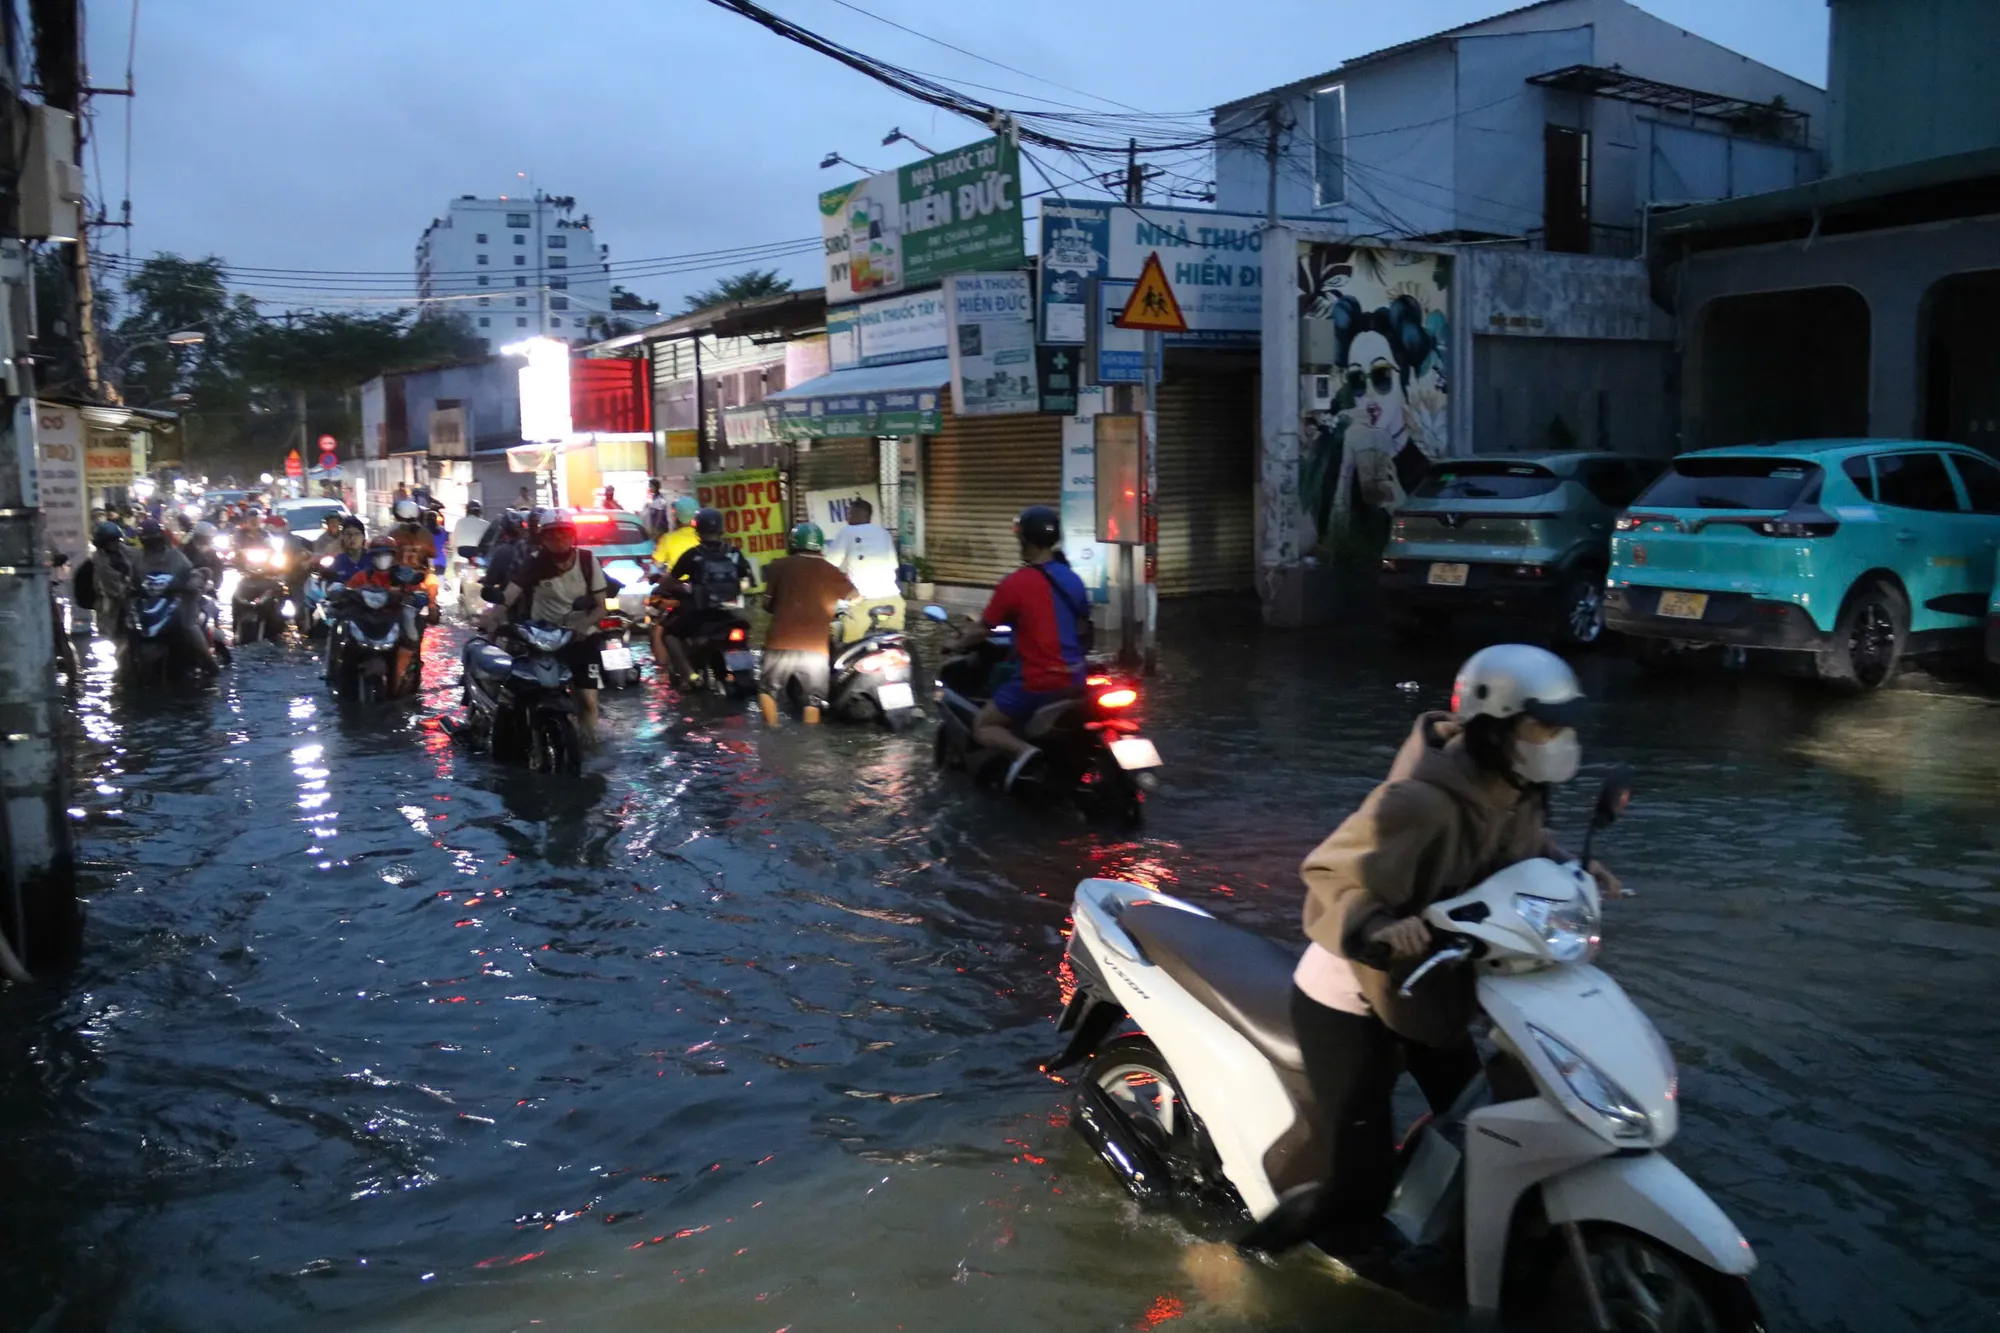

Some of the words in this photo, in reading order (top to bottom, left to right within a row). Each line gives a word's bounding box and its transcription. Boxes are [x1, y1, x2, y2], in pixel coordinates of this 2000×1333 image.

[912, 162, 936, 187] NHÀ
[936, 151, 975, 179] THUỐC
[900, 185, 952, 235] HIỀN
[958, 171, 1014, 220] ĐỨC
[1136, 218, 1190, 248] NHÀ
[1197, 221, 1263, 252] THUỐ
[956, 276, 981, 290] NHÀ
[984, 275, 1025, 290] THUỐC
[1175, 254, 1233, 286] HIỀN
[882, 300, 915, 322] THUỐC
[957, 291, 992, 312] HIỀN
[995, 292, 1028, 311] ĐỨC
[697, 480, 781, 508] PHOTO
[725, 507, 771, 533] OPY
[1103, 955, 1150, 999] VISION
